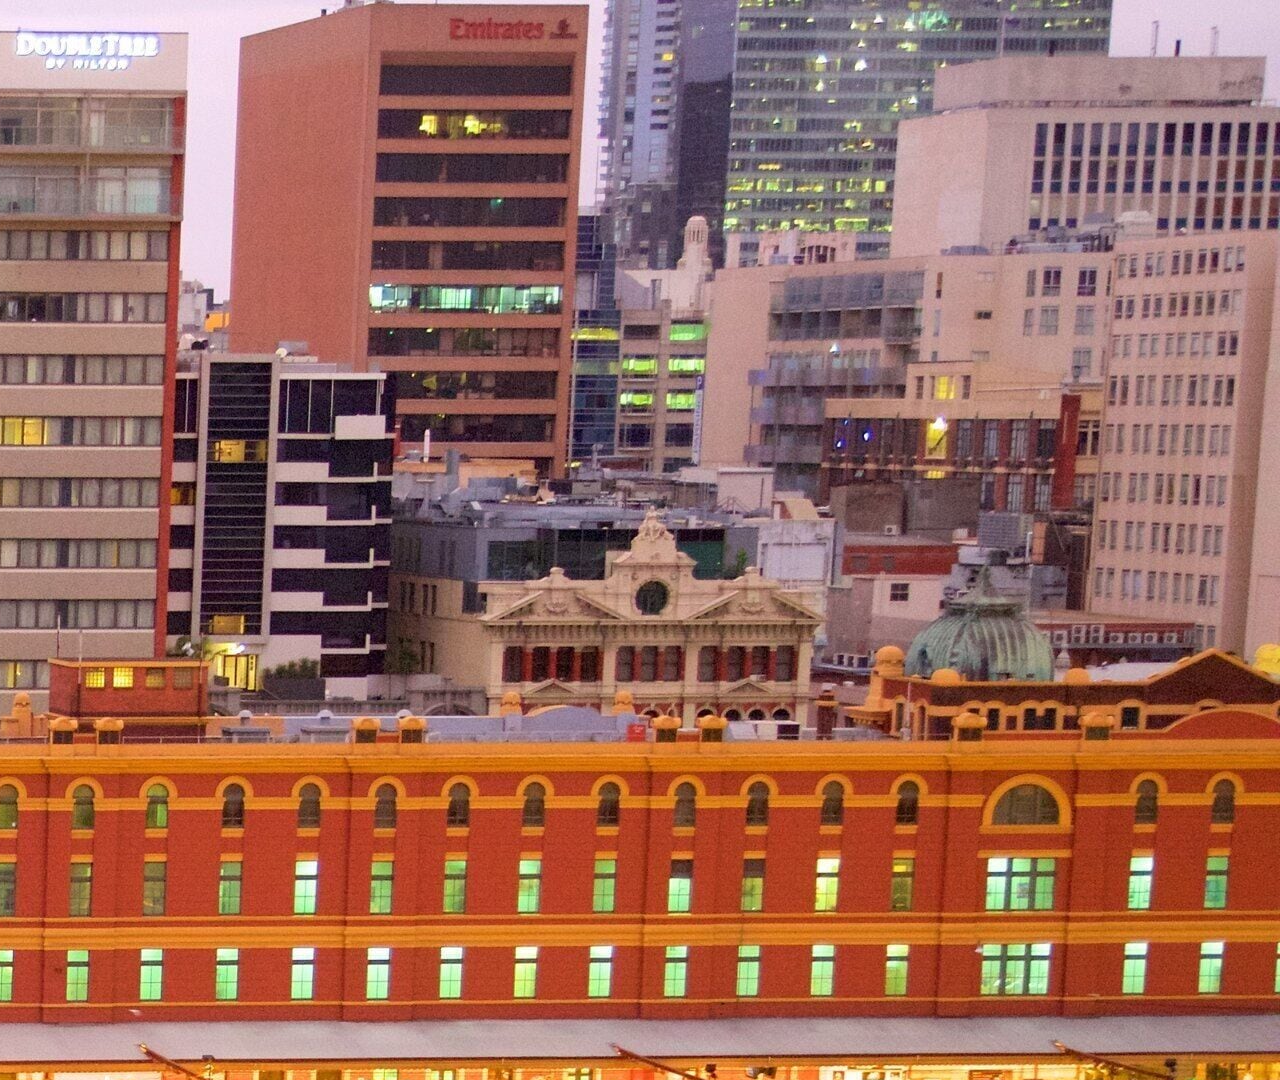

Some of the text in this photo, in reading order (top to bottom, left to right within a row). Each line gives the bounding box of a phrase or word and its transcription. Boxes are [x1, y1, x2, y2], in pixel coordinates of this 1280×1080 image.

[449, 17, 544, 40] Emirates
[45, 57, 129, 71] BY HILTON
